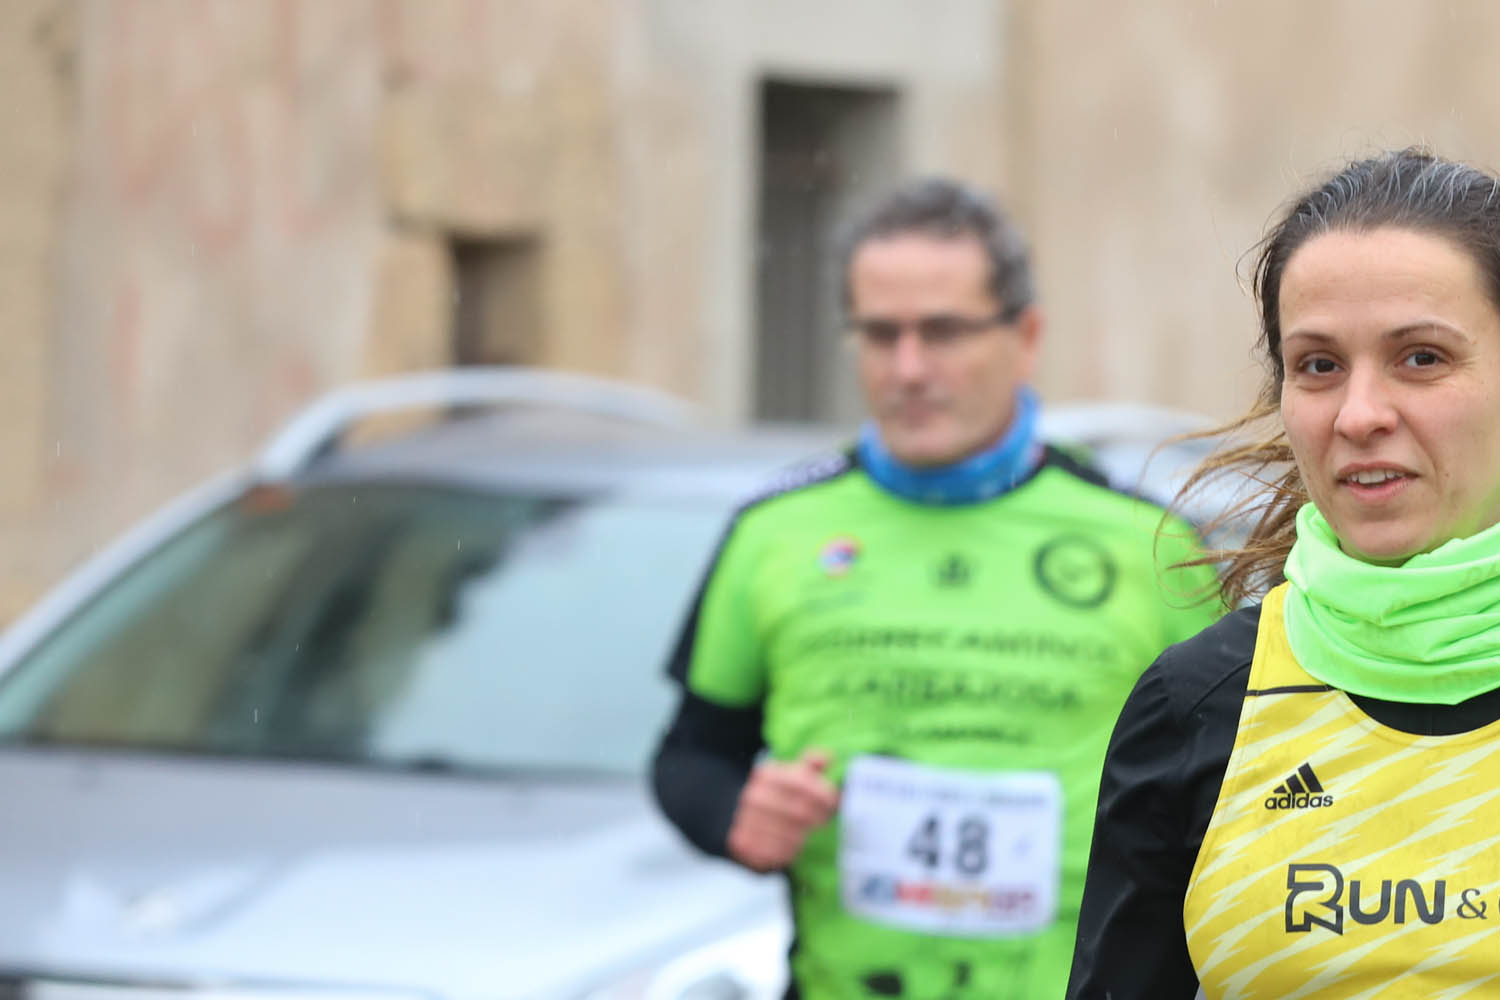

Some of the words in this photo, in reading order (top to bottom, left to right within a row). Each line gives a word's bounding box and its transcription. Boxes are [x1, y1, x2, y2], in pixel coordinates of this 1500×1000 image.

[1265, 791, 1334, 811] adidas
[904, 815, 990, 877] 48
[1284, 863, 1447, 936] RUN
[1456, 887, 1488, 920] &
